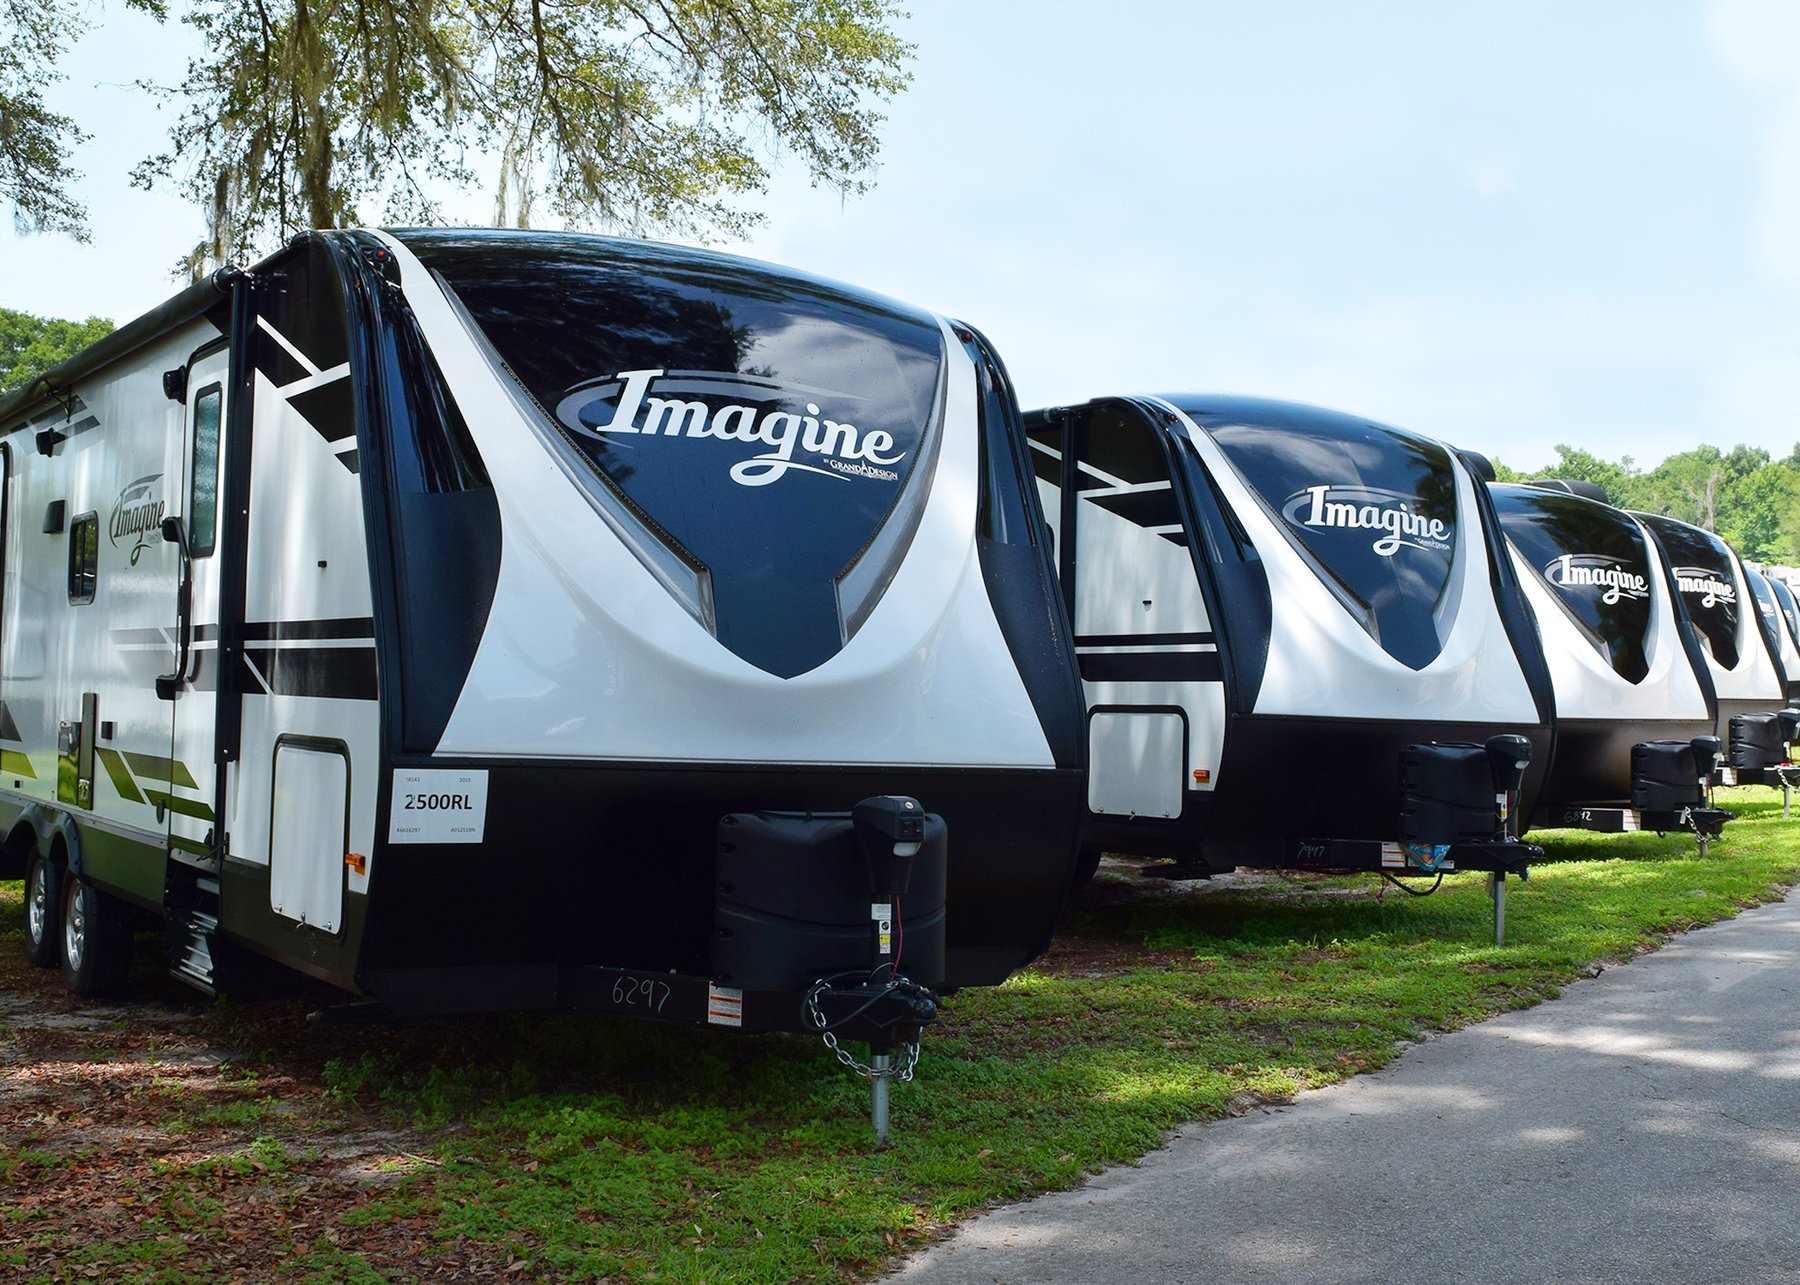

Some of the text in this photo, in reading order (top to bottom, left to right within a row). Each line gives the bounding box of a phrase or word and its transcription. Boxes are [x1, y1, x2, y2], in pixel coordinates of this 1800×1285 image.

[595, 368, 906, 487] Imagine
[113, 491, 165, 567] Imagine
[1303, 485, 1451, 556] Imagine
[1557, 554, 1649, 605] Imagine
[404, 794, 473, 810] 2500RL
[612, 976, 671, 1014] 6297
